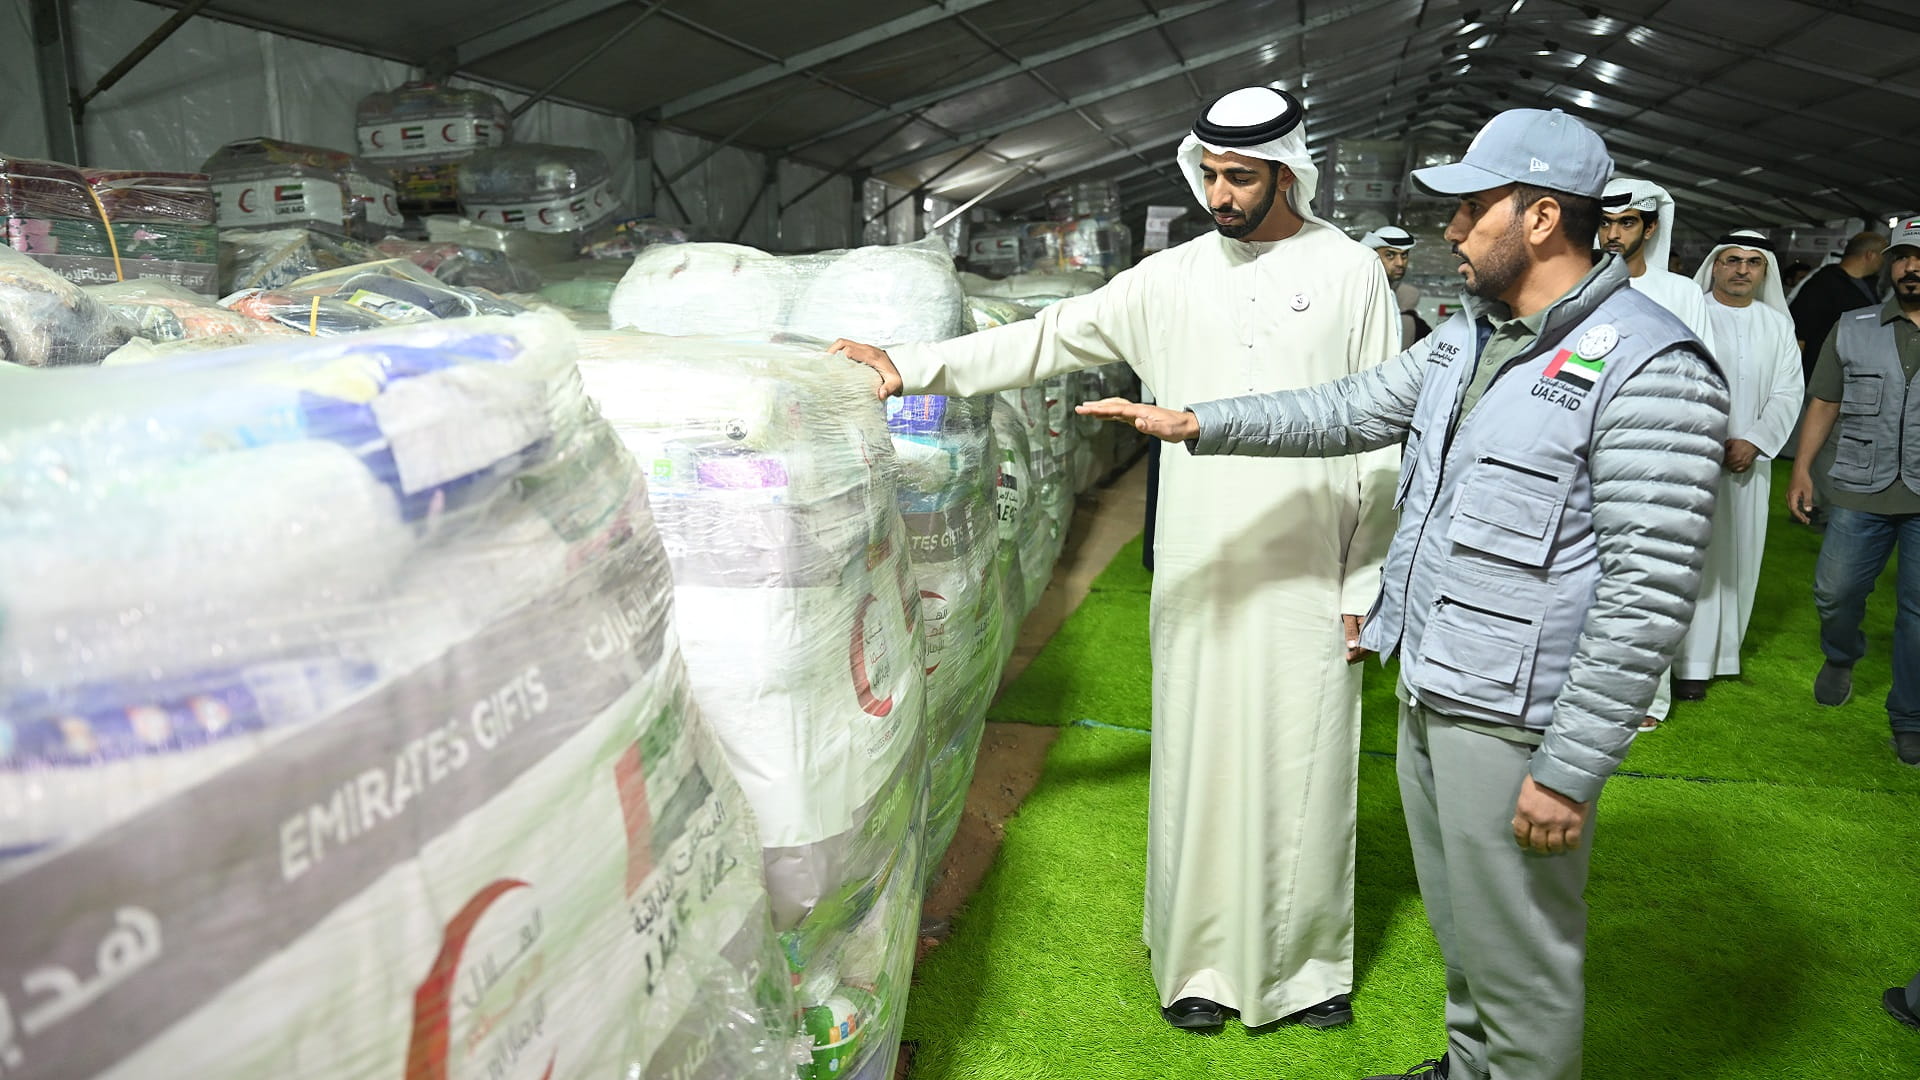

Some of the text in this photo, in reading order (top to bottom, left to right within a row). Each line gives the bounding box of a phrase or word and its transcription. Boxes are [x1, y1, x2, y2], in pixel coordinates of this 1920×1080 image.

[1531, 383, 1581, 411] UAE AID
[279, 665, 550, 883] EMIRATES GIFTS
